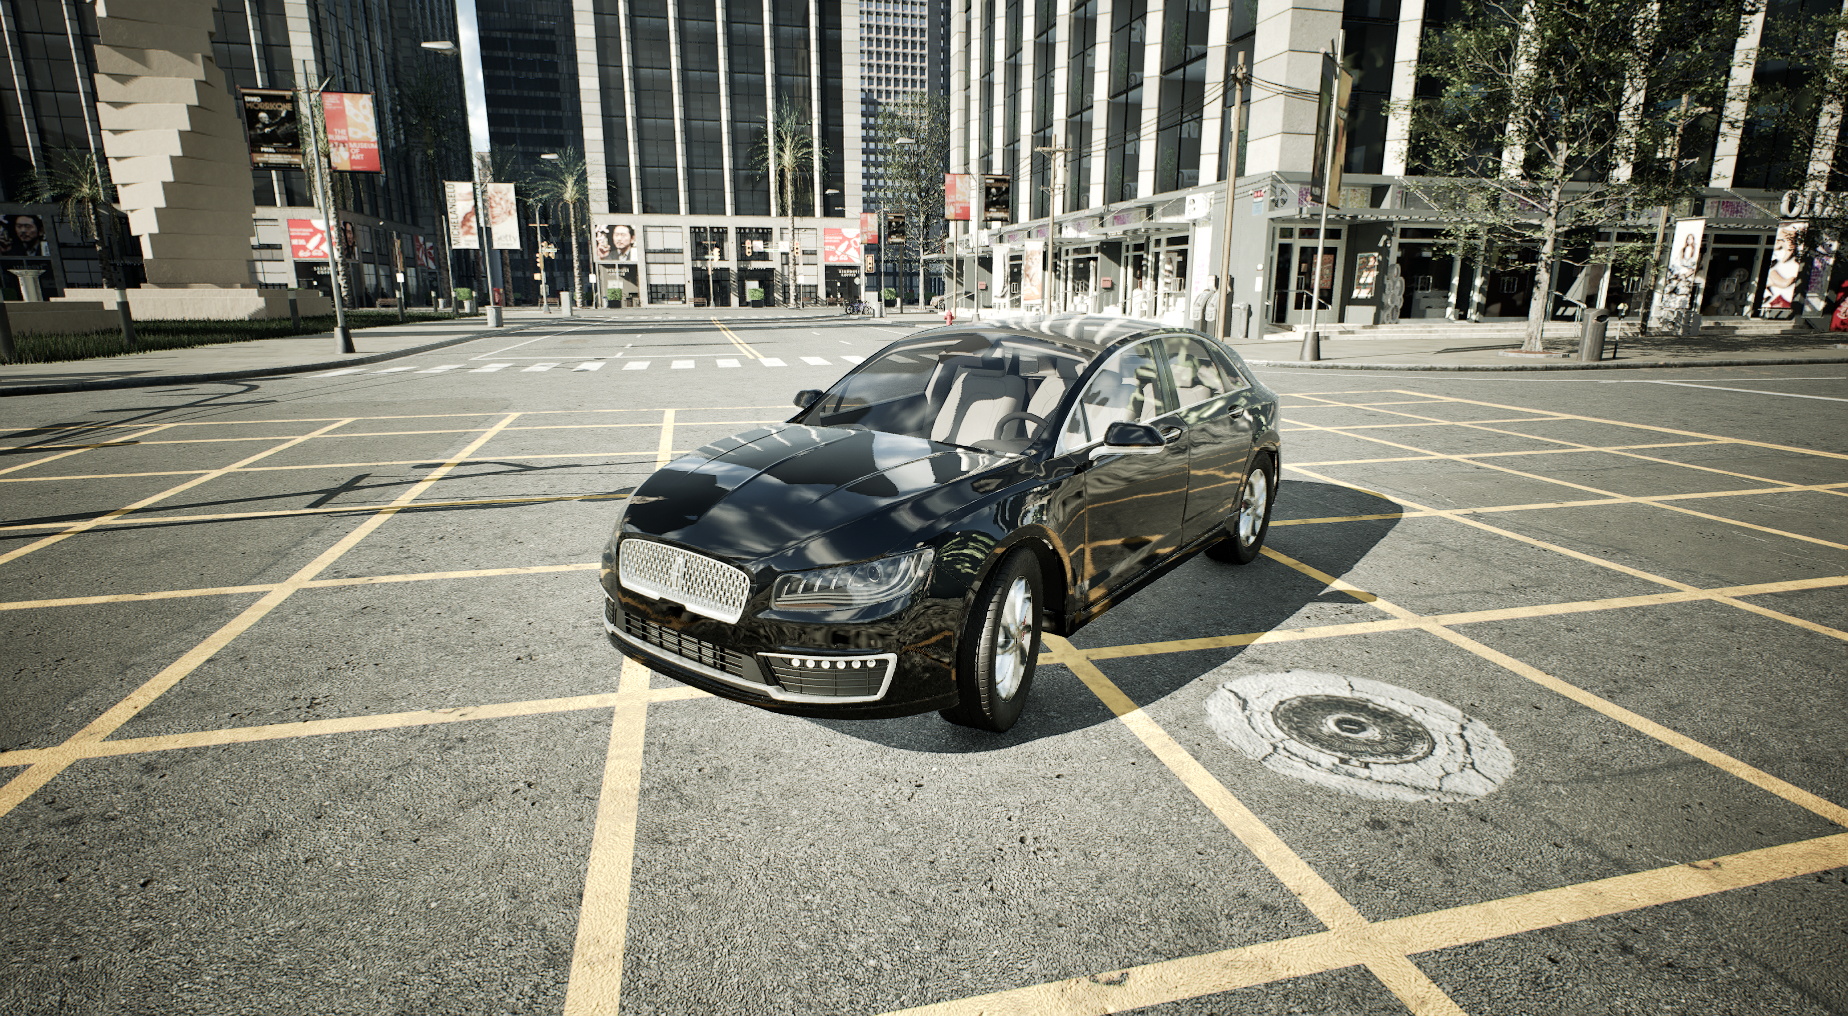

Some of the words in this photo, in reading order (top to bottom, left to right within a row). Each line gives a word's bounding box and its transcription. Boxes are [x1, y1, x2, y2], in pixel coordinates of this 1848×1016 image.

[246, 102, 293, 111] MORRICONE
[334, 128, 347, 136] THE
[446, 183, 461, 246] MICHELANGELO
